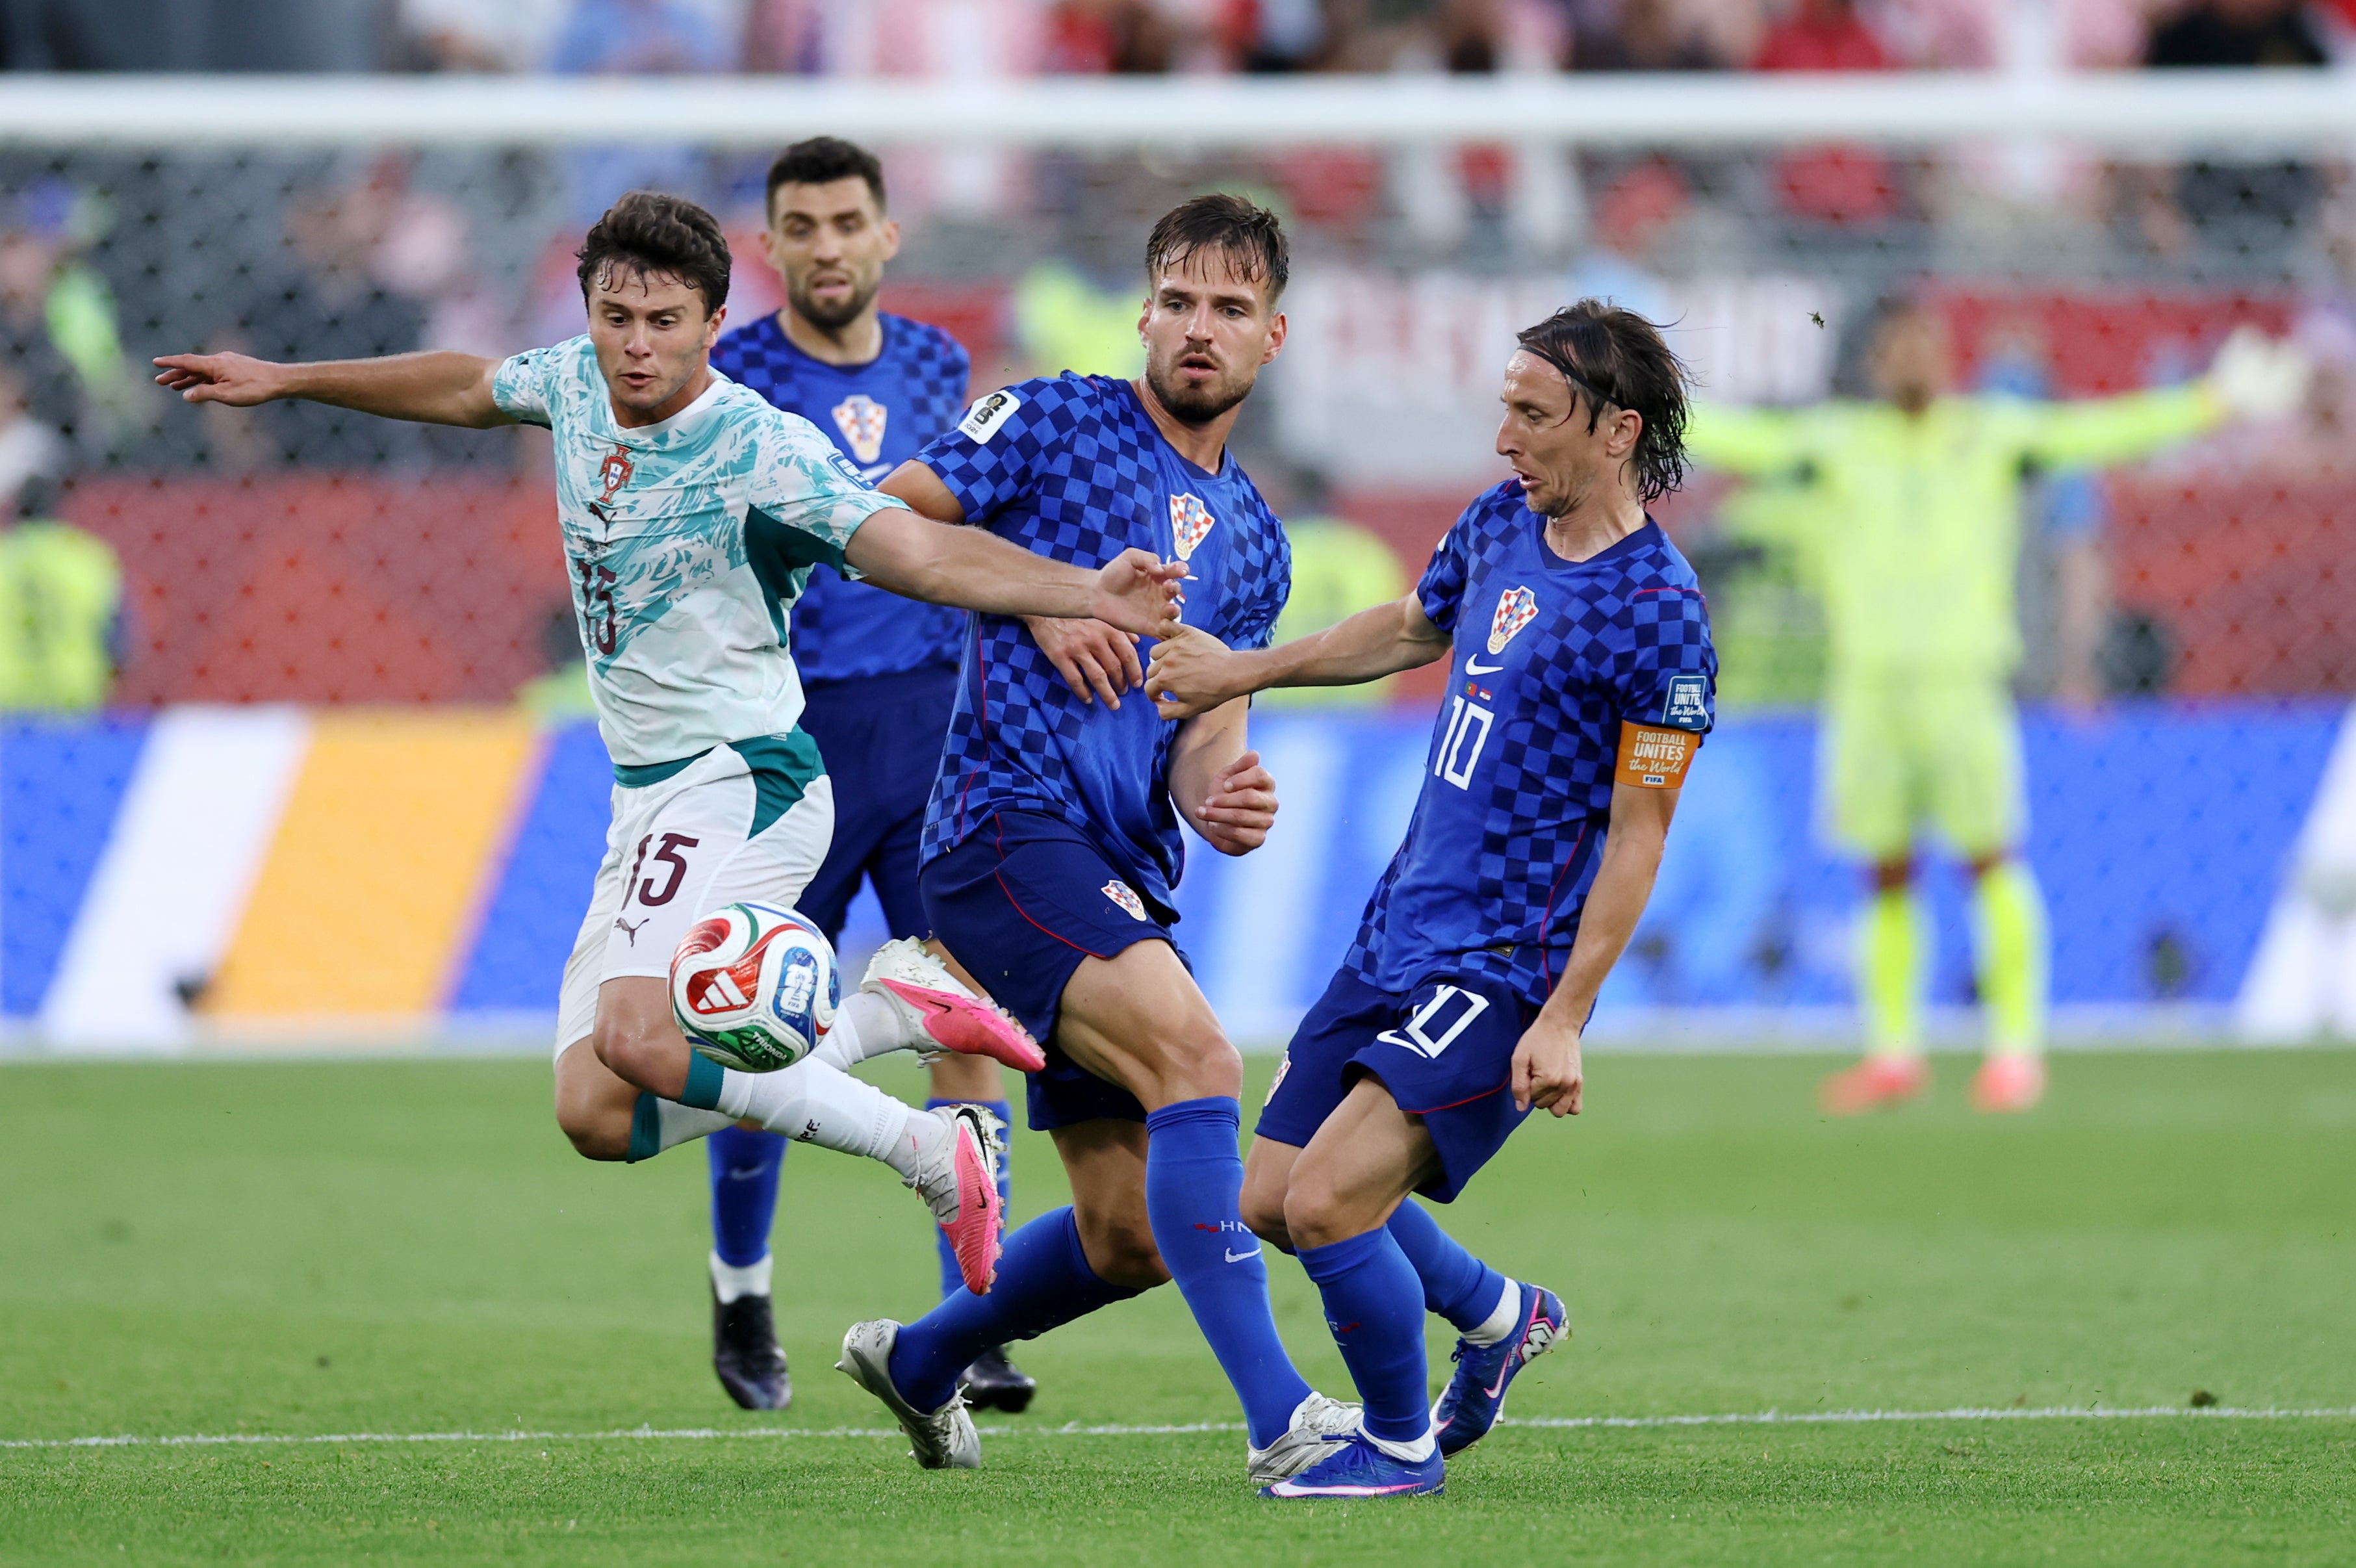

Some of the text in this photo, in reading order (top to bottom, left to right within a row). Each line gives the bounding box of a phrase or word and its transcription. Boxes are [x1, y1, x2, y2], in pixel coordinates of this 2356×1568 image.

[578, 559, 617, 655] 15
[1434, 694, 1495, 791] 10
[1633, 742, 1685, 761] UNITES
[1636, 731, 1687, 746] FOOTBALL
[1629, 758, 1684, 775] the World
[621, 832, 700, 912] 15
[787, 1001, 800, 1009] FIFA
[1404, 984, 1490, 1059] 0
[752, 1031, 787, 1060] TRIONDA
